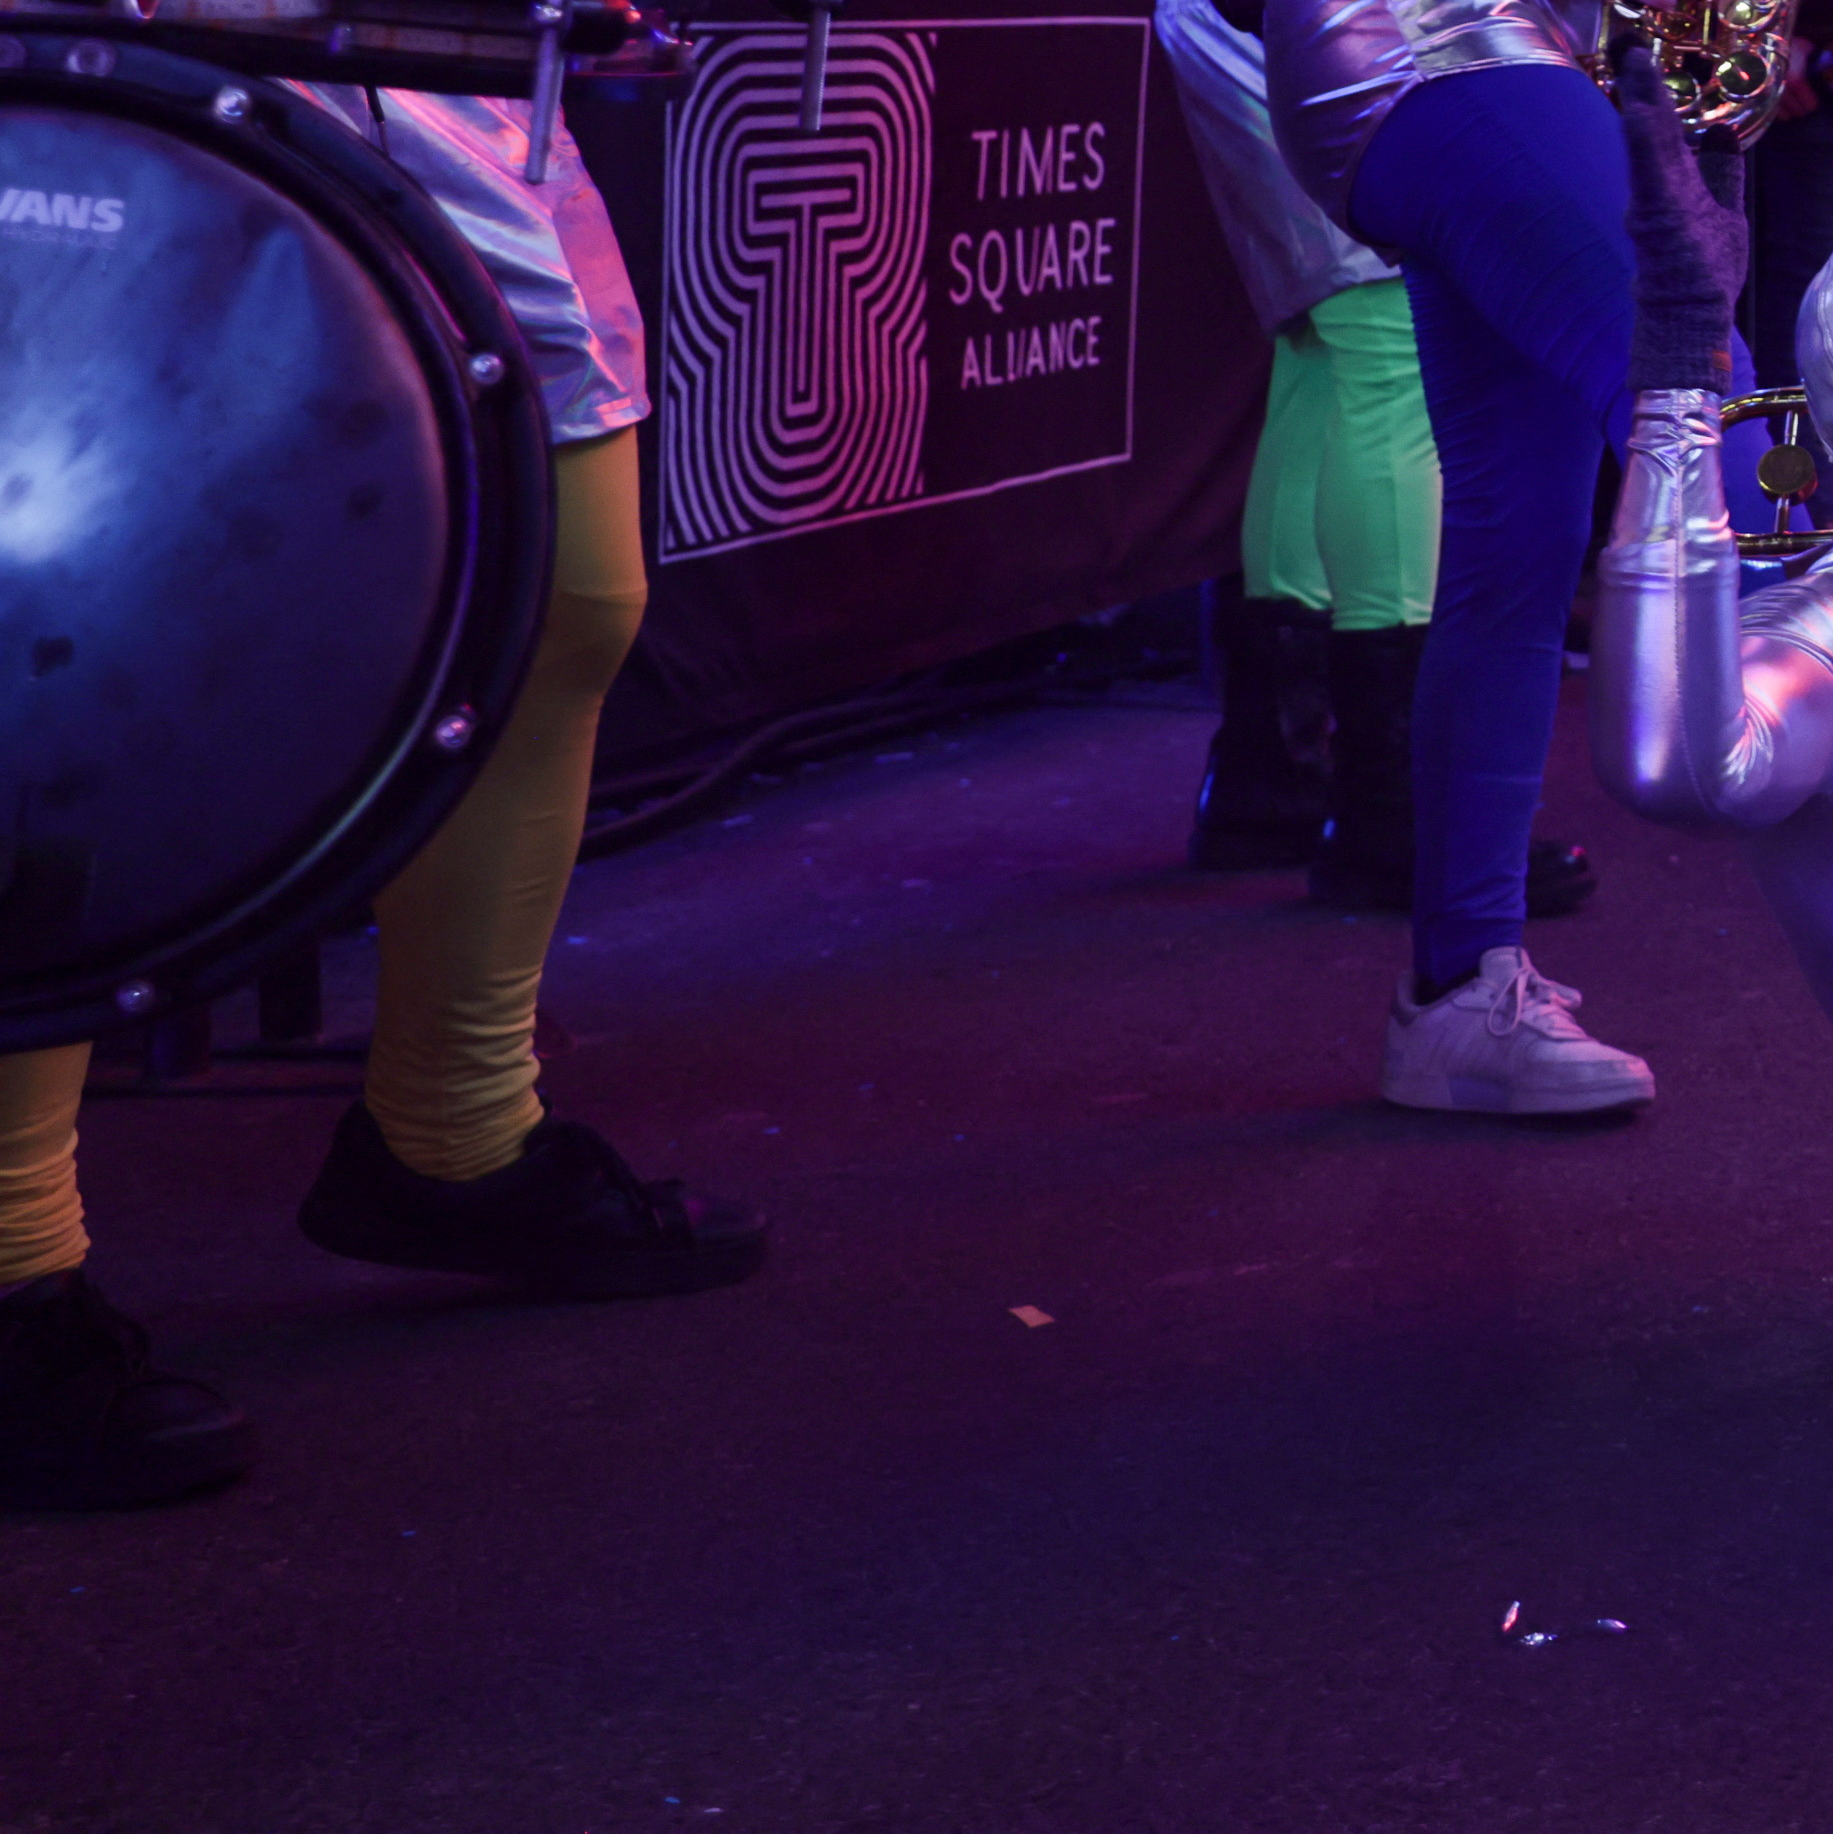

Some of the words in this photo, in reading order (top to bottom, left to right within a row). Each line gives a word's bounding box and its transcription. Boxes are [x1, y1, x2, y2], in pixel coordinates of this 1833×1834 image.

[971, 122, 1106, 201] TIMES
[949, 218, 1117, 314] SQUARE
[960, 316, 1104, 390] ALLIANCE
